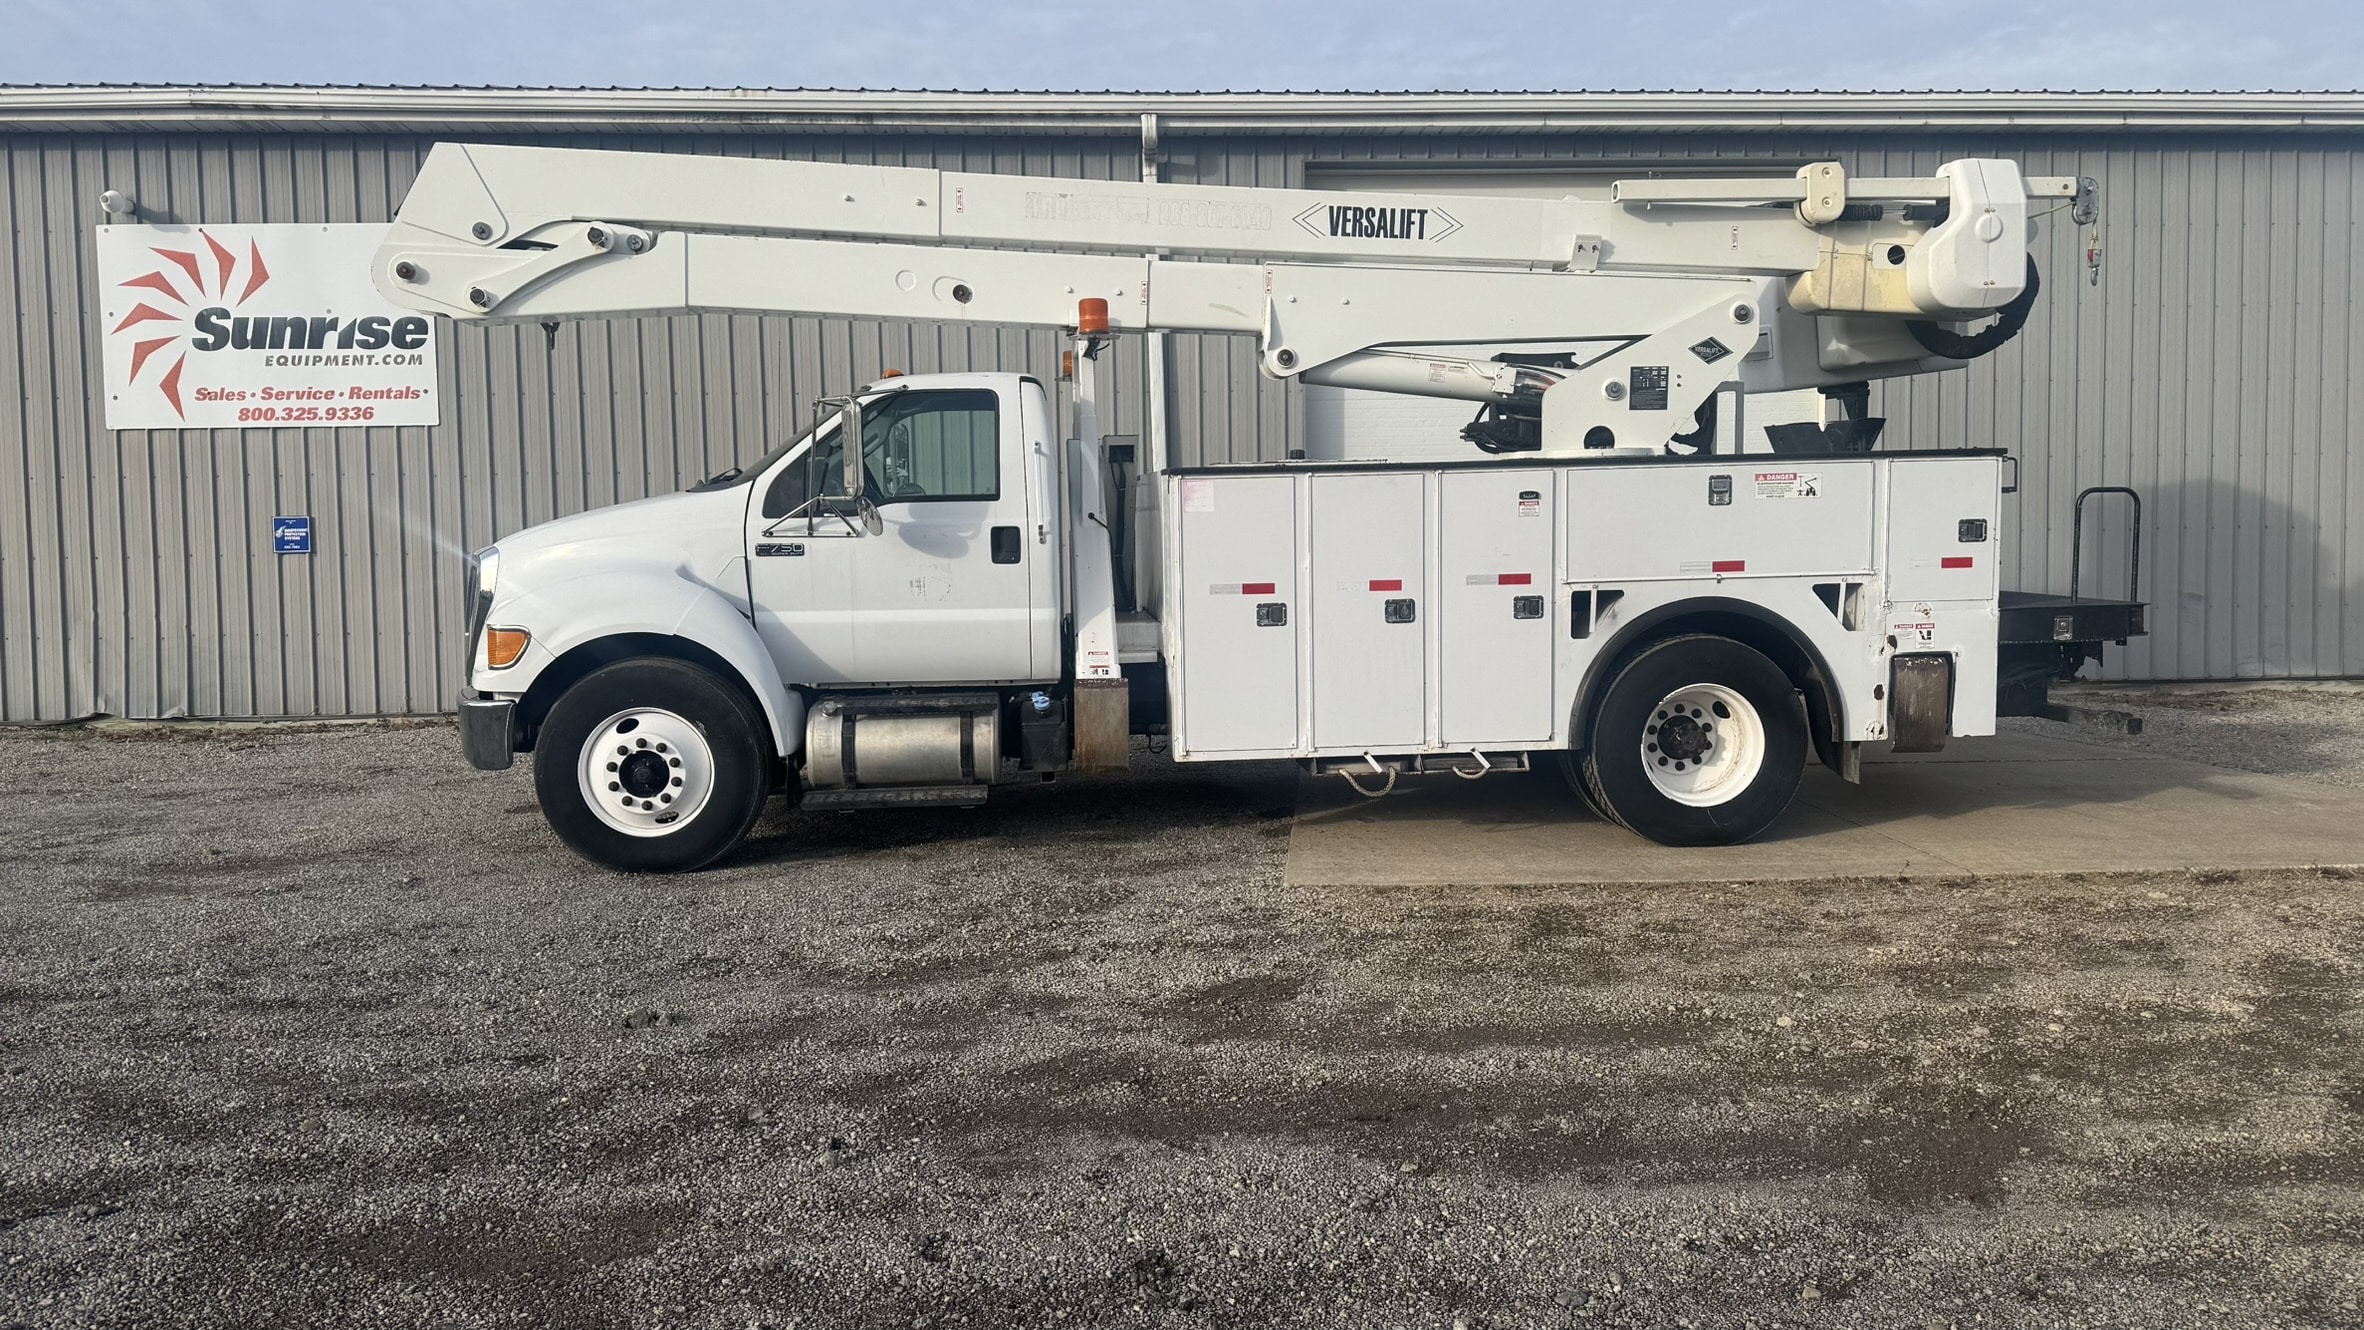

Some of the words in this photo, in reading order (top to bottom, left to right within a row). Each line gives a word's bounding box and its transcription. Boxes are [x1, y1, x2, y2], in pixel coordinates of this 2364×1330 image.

[1329, 205, 1428, 240] VERSALIFT
[192, 307, 428, 351] Sunrise
[1695, 346, 1719, 354] VERSALIFT
[265, 354, 423, 367] EQUIPMENT.COM
[194, 387, 246, 401] Sales
[260, 386, 335, 401] Service
[348, 386, 421, 400] Rentals
[238, 406, 374, 421] 800.325.9336
